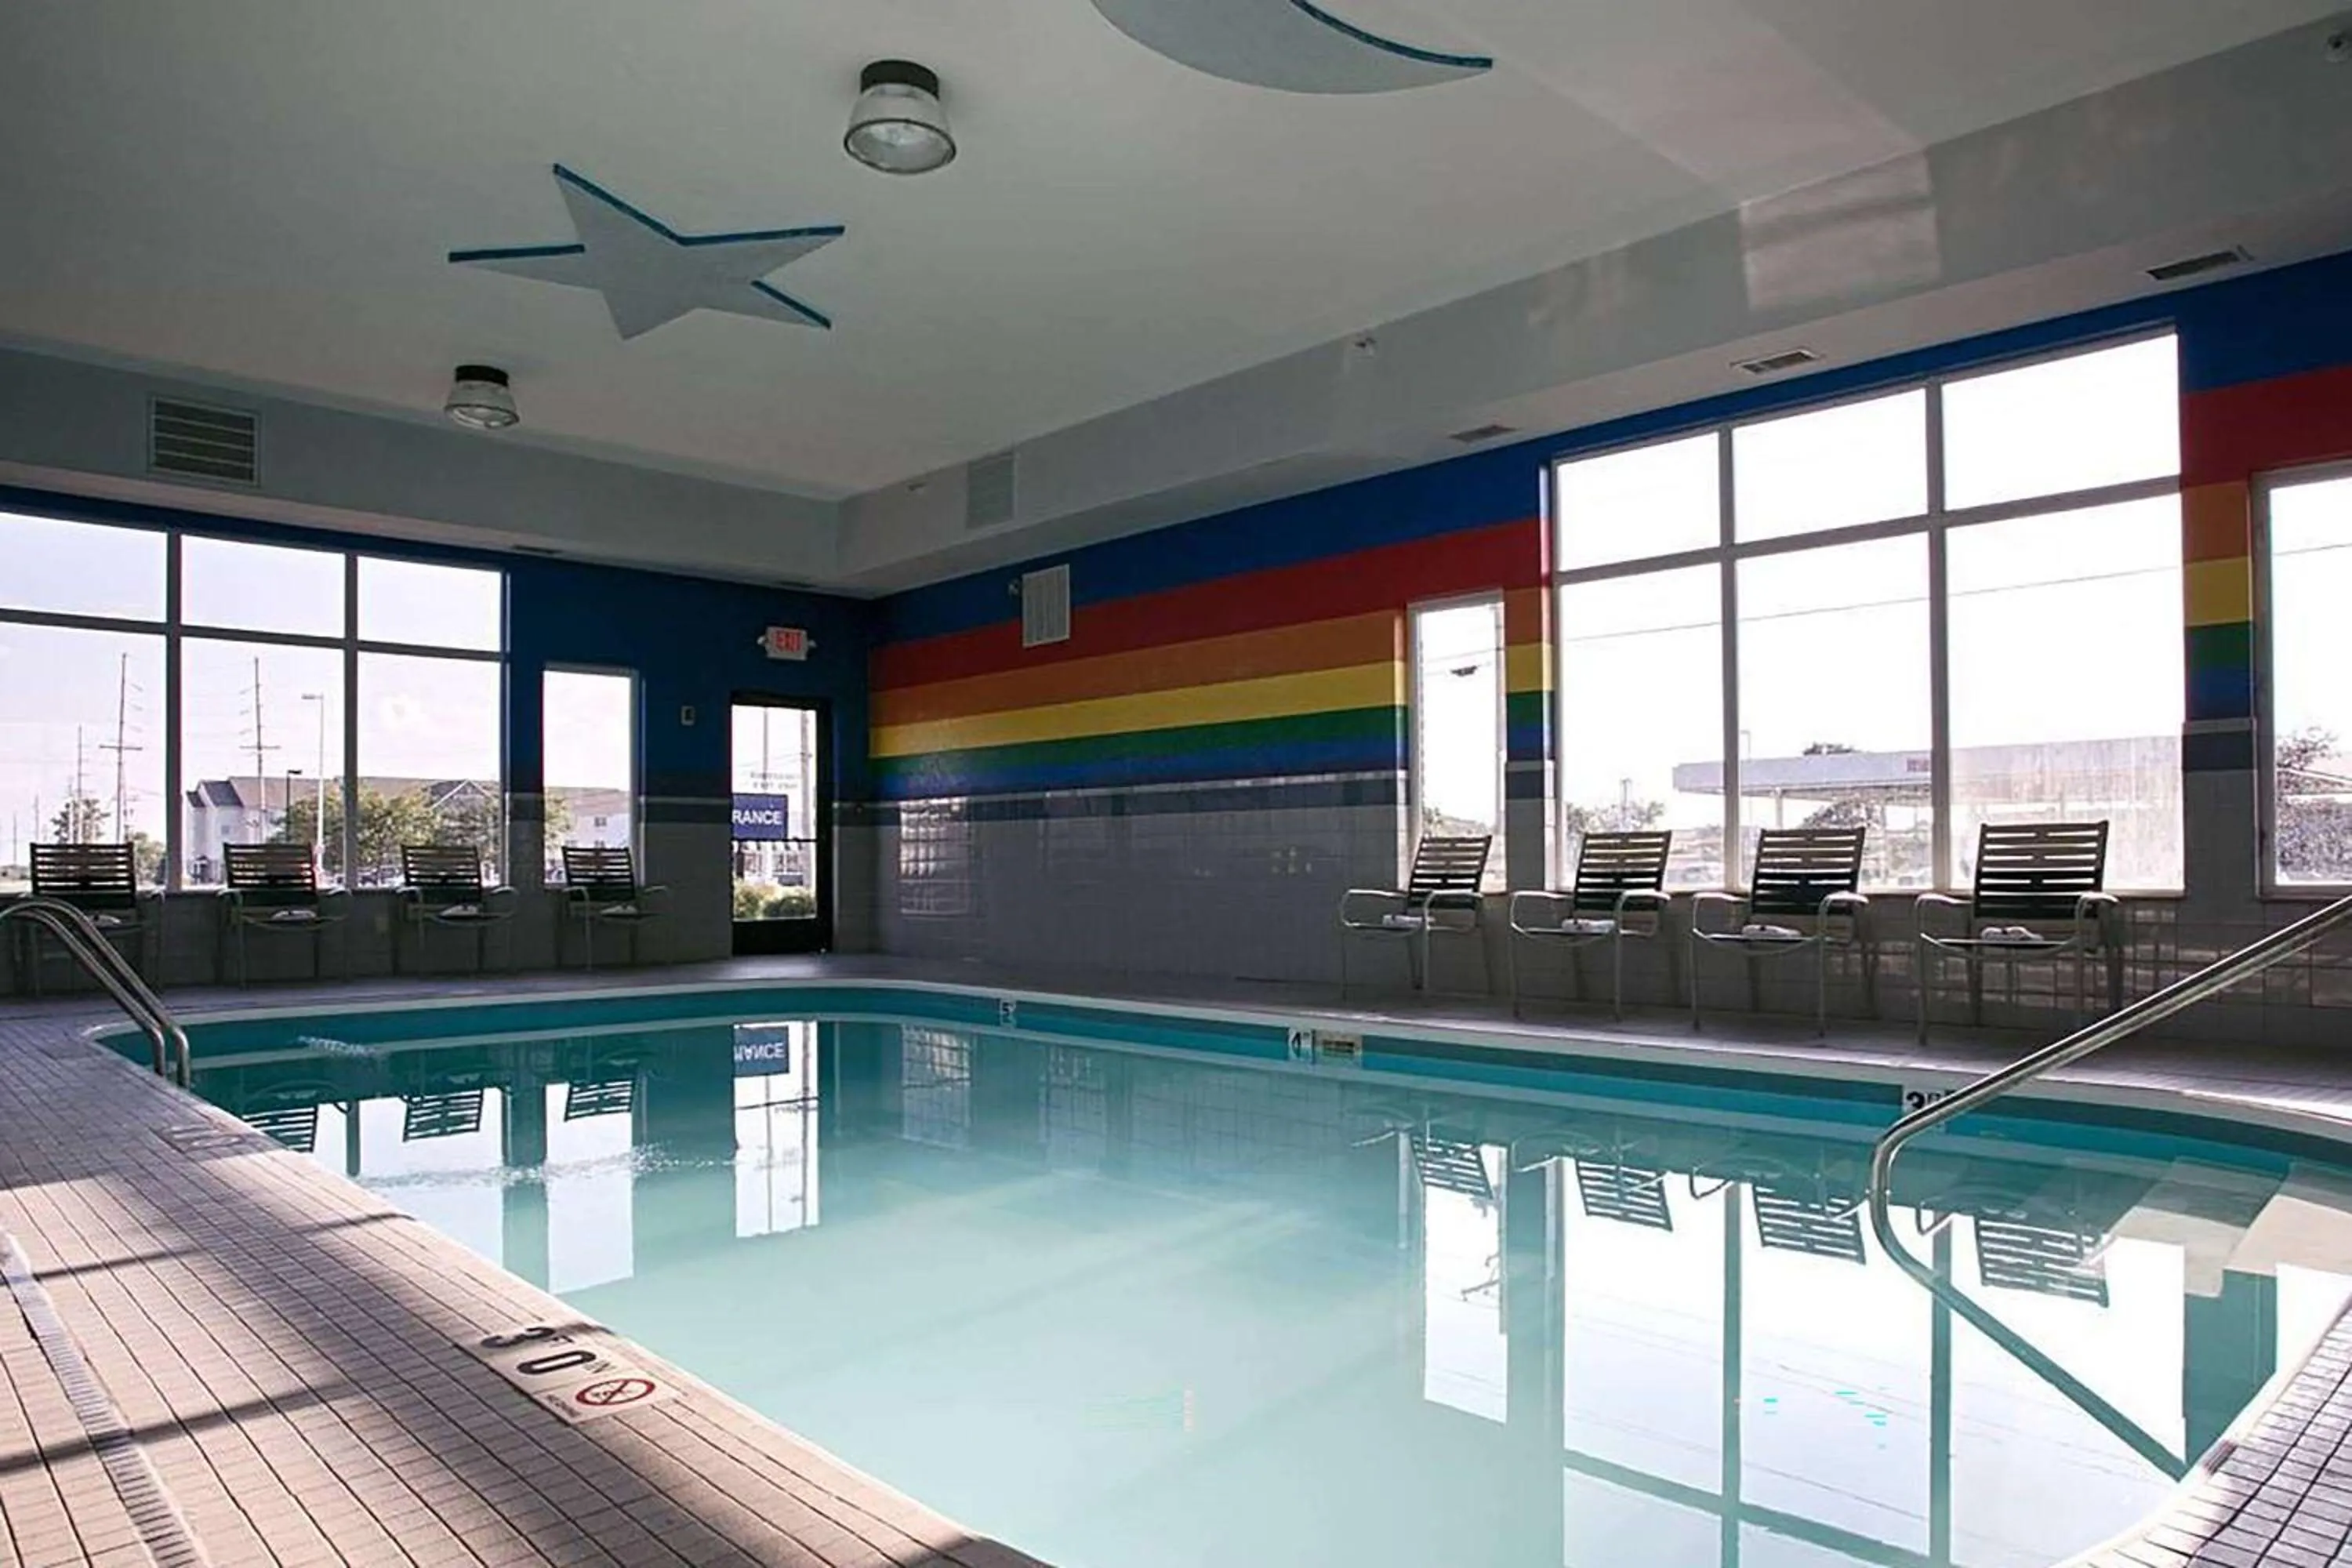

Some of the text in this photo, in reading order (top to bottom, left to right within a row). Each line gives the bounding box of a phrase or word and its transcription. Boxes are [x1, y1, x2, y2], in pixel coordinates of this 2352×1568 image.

[771, 630, 803, 652] EXIT
[731, 809, 782, 826] RANCE
[480, 1326, 556, 1348] 3
